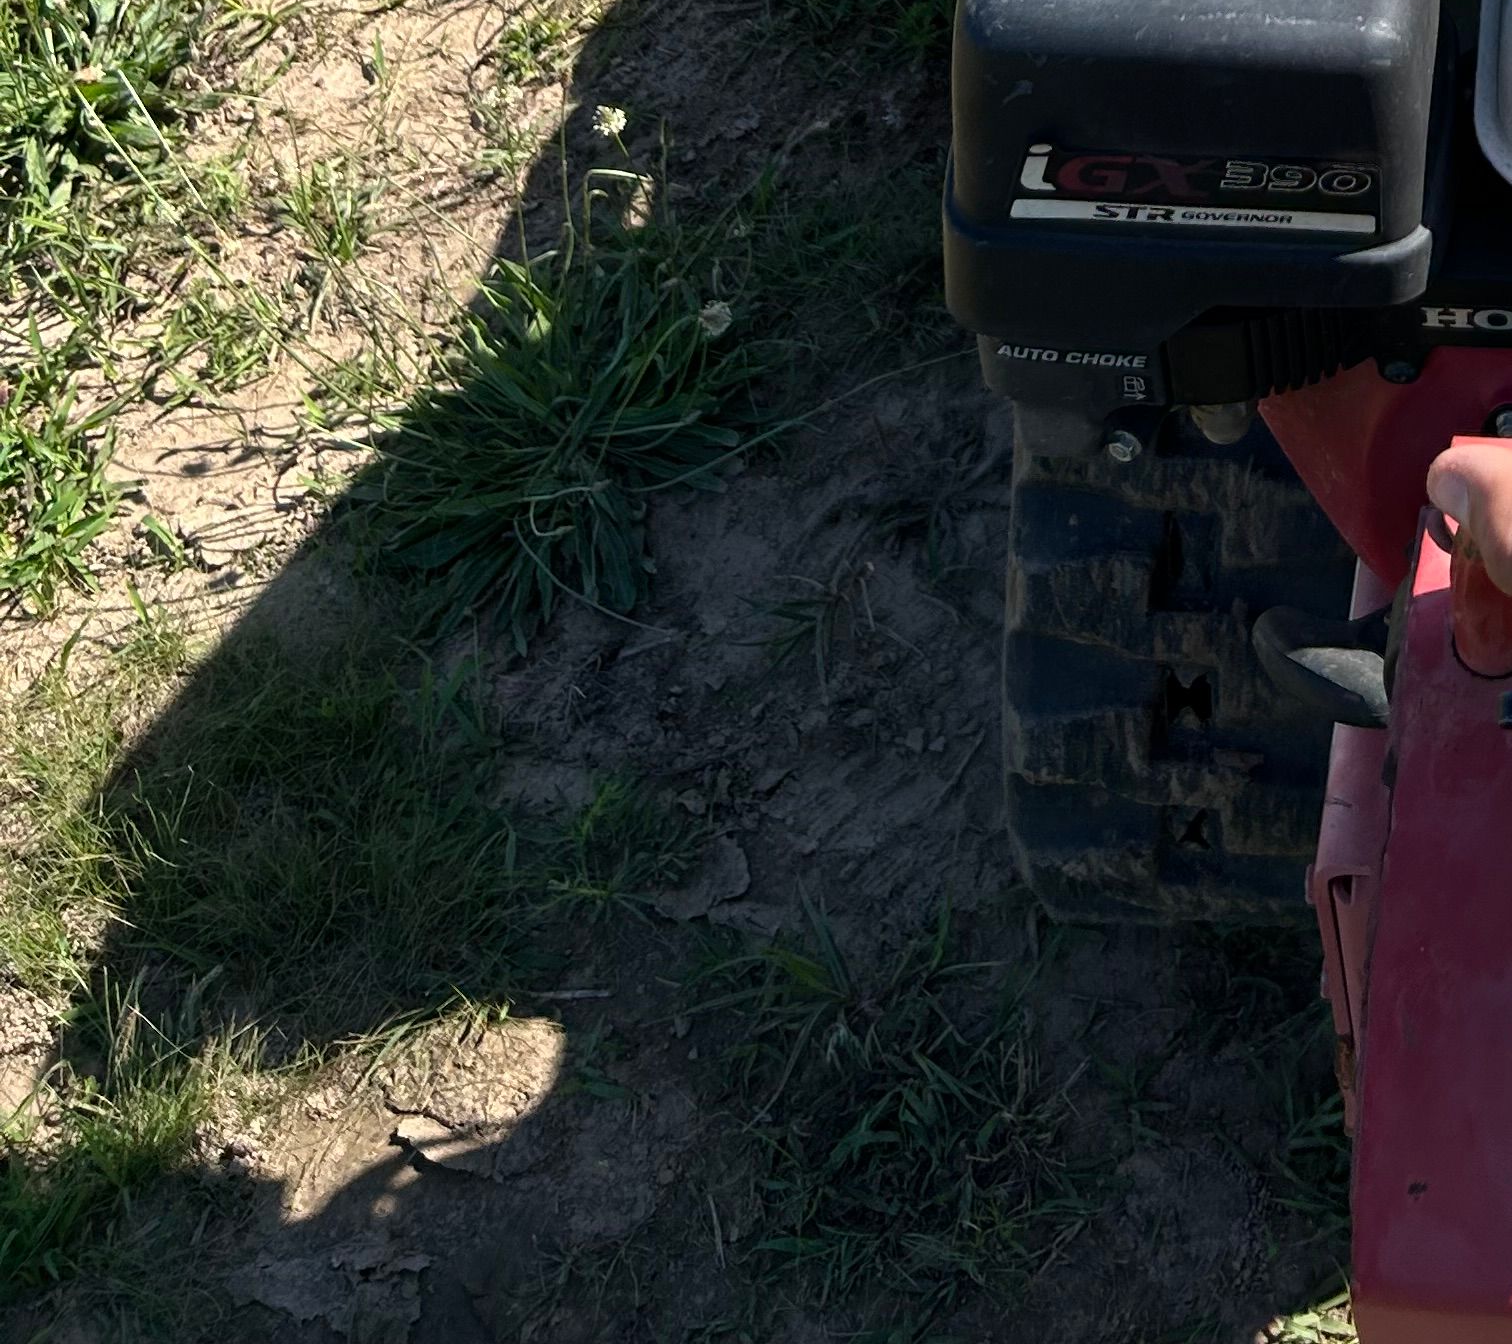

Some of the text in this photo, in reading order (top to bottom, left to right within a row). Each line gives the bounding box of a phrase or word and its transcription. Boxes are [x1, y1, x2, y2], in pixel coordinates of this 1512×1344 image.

[1219, 160, 1372, 195] 390
[1092, 203, 1293, 225] STR GOVERNOR
[997, 344, 1148, 368] AUTO CHOKE
